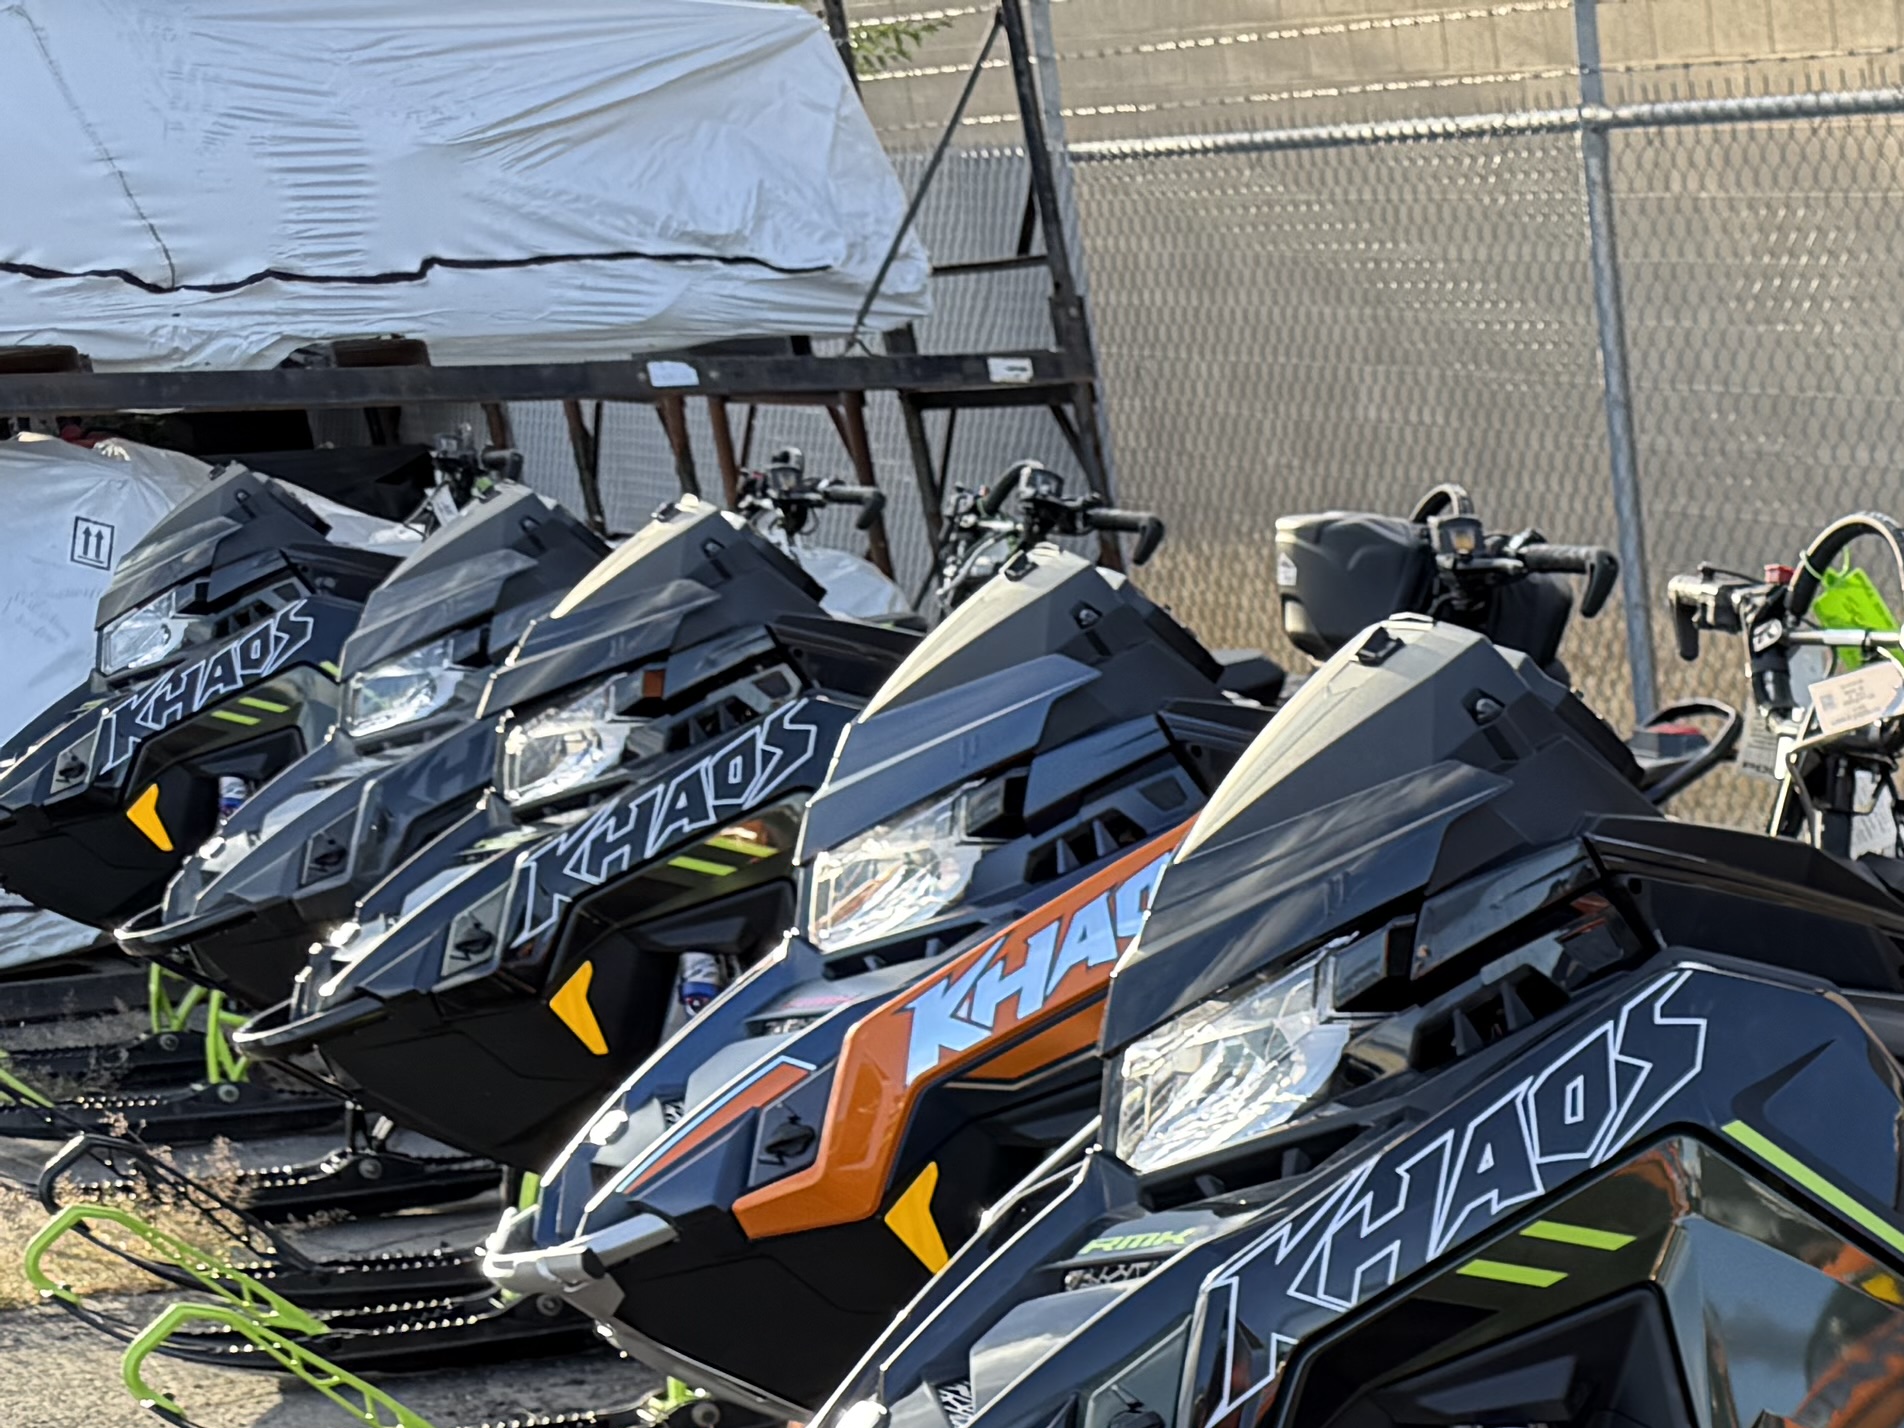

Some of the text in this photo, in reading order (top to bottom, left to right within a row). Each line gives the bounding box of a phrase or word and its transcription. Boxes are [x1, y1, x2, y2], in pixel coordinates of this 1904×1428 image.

[100, 599, 314, 774] KHAOS
[510, 697, 817, 948] KHAOS
[896, 850, 1190, 1088] KHAO
[1077, 1227, 1197, 1255] RMK
